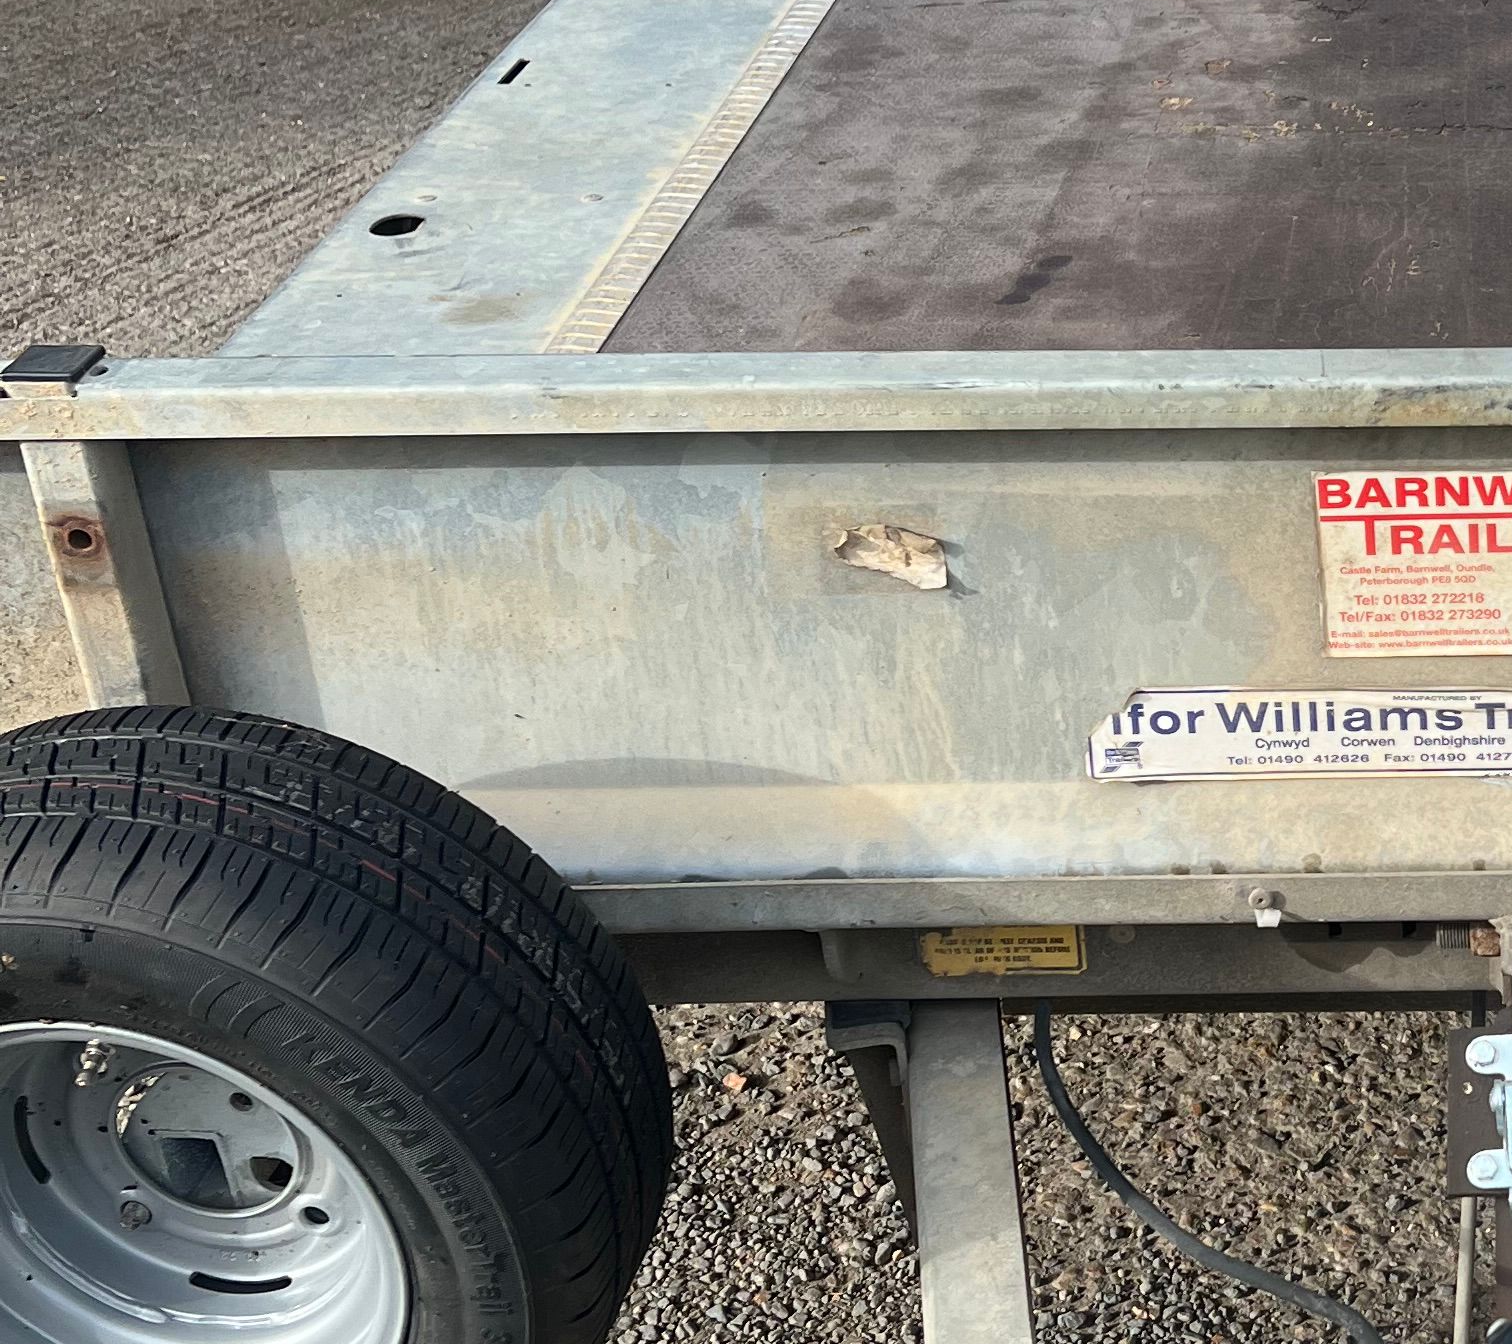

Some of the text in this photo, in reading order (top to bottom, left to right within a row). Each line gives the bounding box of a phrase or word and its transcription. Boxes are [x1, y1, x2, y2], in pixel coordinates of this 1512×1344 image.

[1340, 566, 1372, 575] Castle
[1374, 565, 1403, 575] Farm,
[1406, 564, 1453, 574] Barnwell,
[1359, 576, 1429, 586] Peterborough
[1354, 594, 1379, 606] Tel:
[1383, 594, 1427, 605] 01832
[1339, 608, 1502, 623] Tel/Fax: 01832 273290
[1110, 703, 1205, 735] Ifor
[1215, 701, 1463, 733] Williams
[1255, 737, 1310, 749] Cynwyd
[1341, 736, 1396, 747] Corwen
[1413, 734, 1506, 749] Denbighshire
[1228, 756, 1252, 766] Tel:
[1257, 754, 1304, 765] 01490
[1313, 754, 1370, 765] 412626
[1384, 753, 1415, 763] Fax:
[1419, 753, 1466, 763] 01490
[280, 1031, 430, 1153] KENDA
